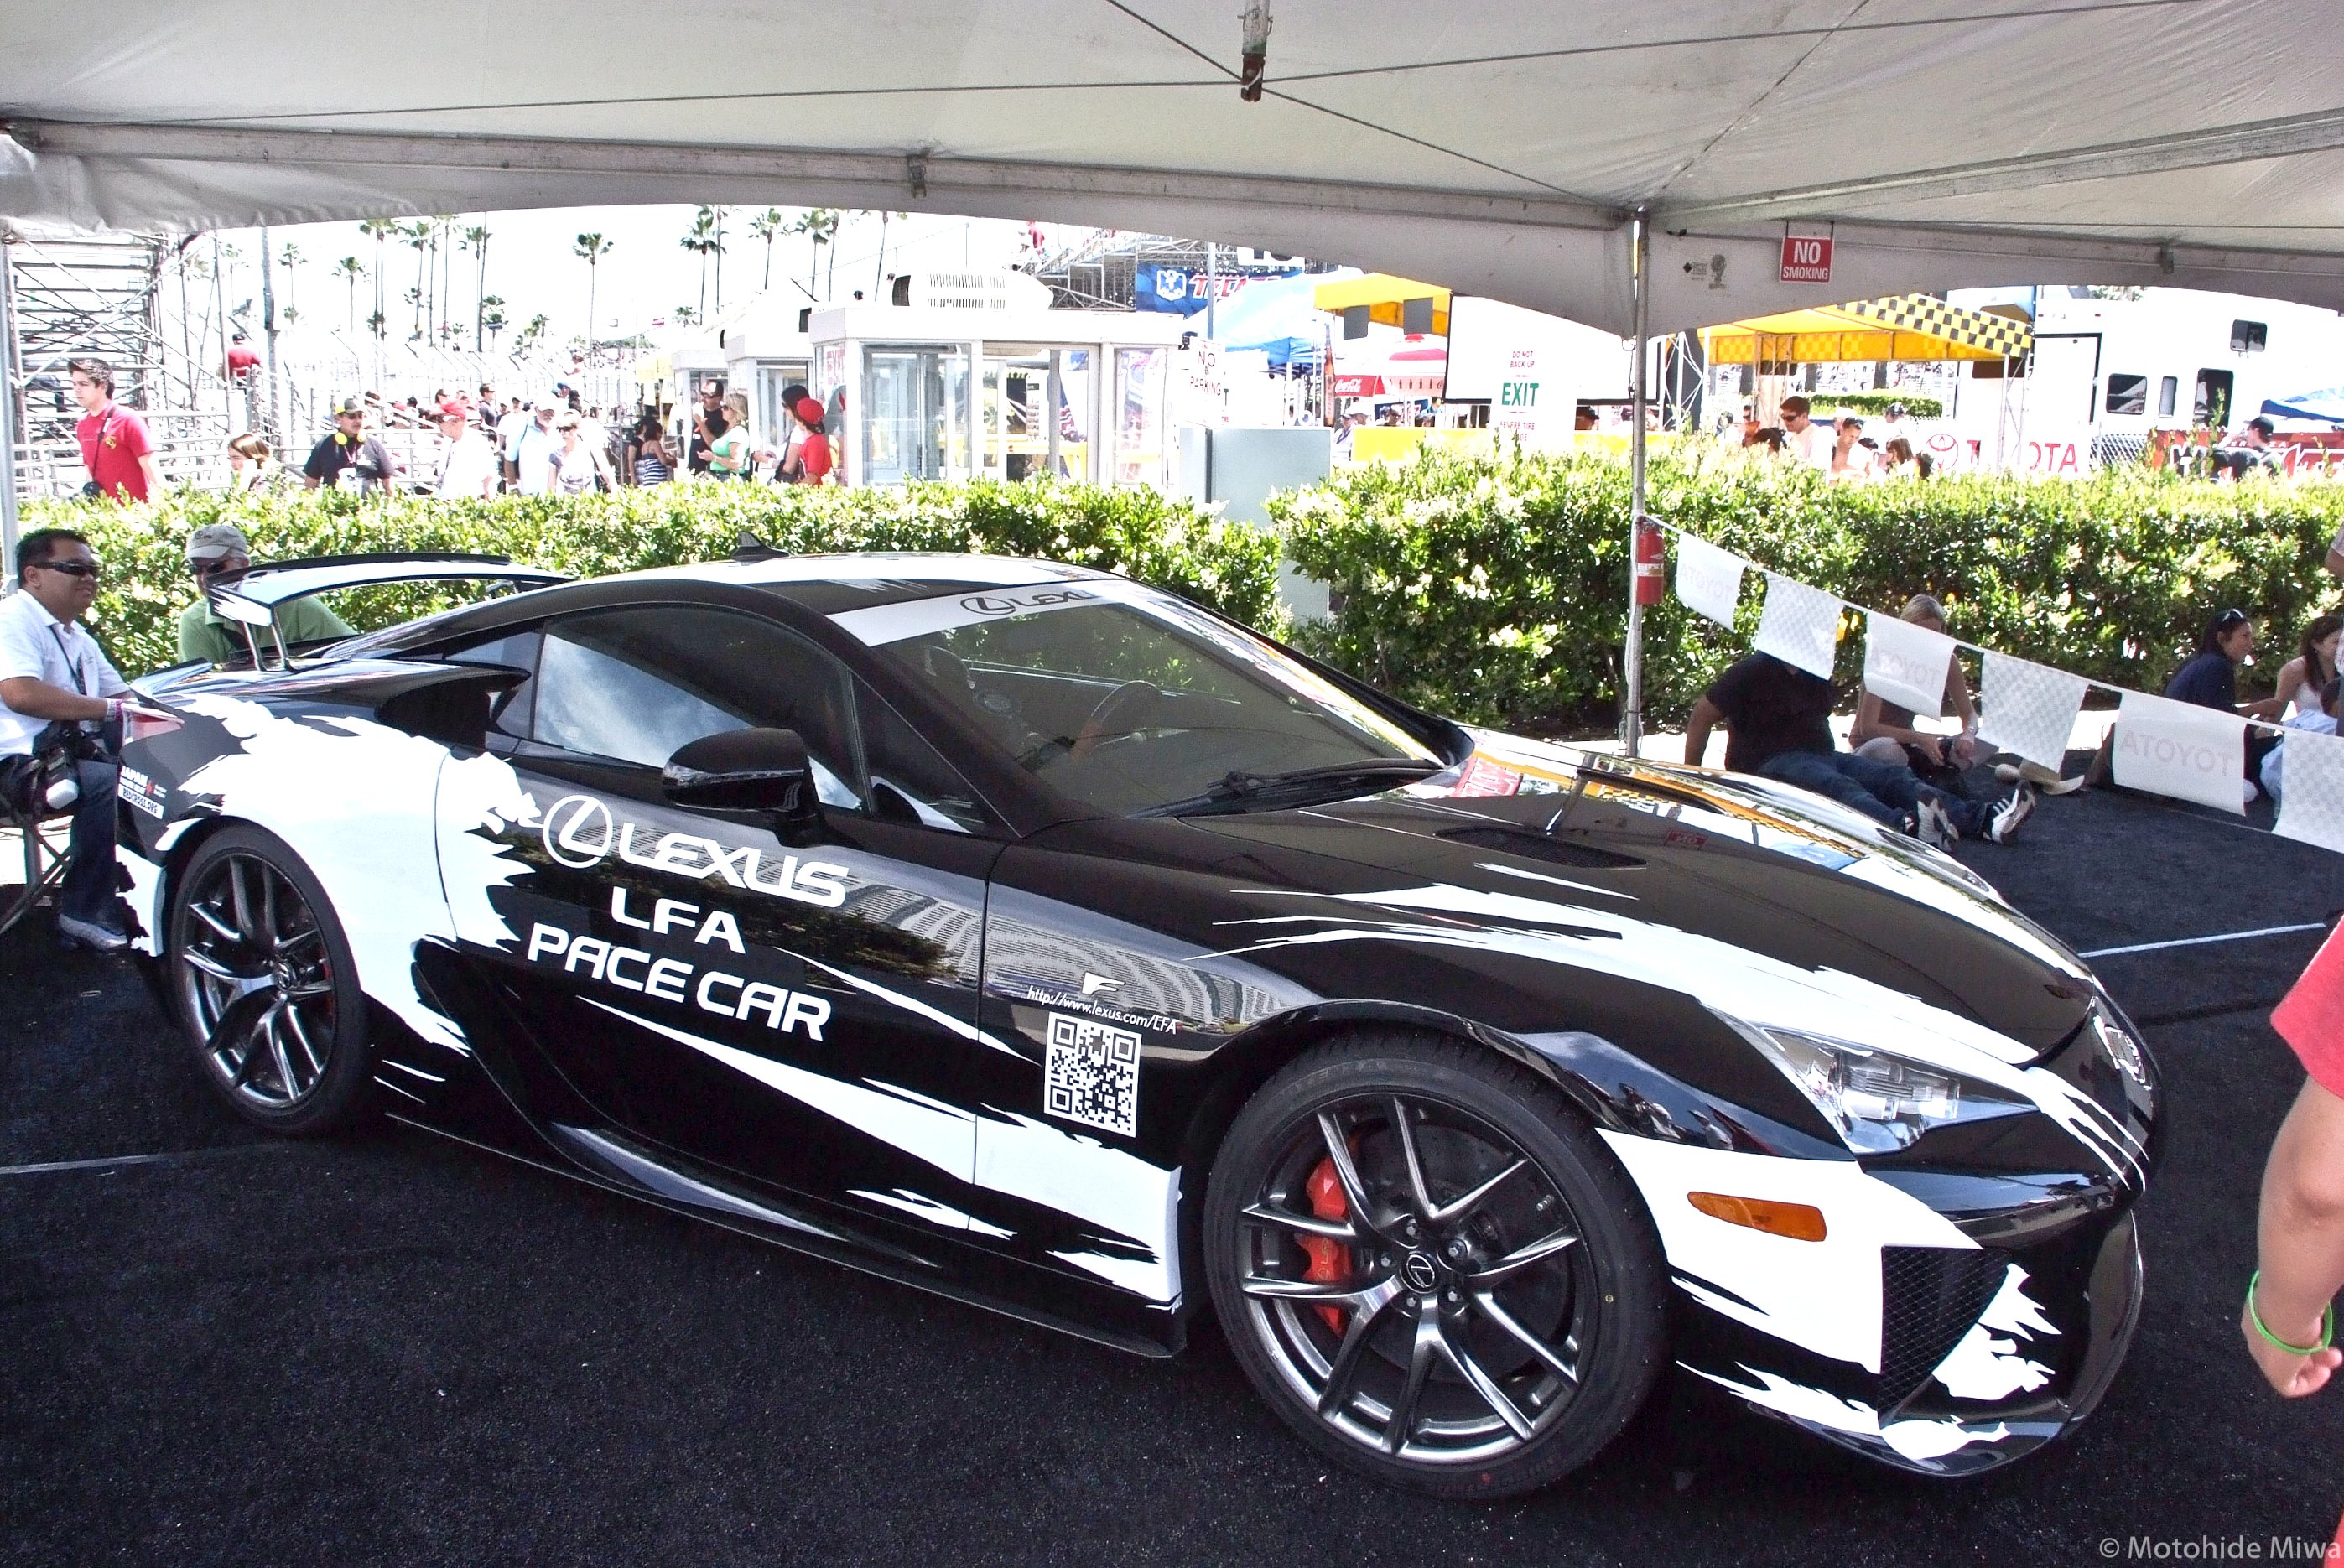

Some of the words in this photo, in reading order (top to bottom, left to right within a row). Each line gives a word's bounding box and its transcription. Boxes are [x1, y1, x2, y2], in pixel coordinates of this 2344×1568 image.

[1793, 241, 1821, 264] NO
[1783, 267, 1829, 280] SMOKING
[1198, 351, 1216, 367] NO
[1190, 376, 1221, 396] PARKING
[1501, 382, 1540, 407] EXIT
[1523, 422, 1536, 430] TIRE
[618, 822, 849, 908] LEXUS
[611, 886, 746, 954] LFA
[527, 922, 694, 1004] PACE
[695, 970, 832, 1041] CAR
[1026, 985, 1177, 1035] http://www.lexus.com/LFA
